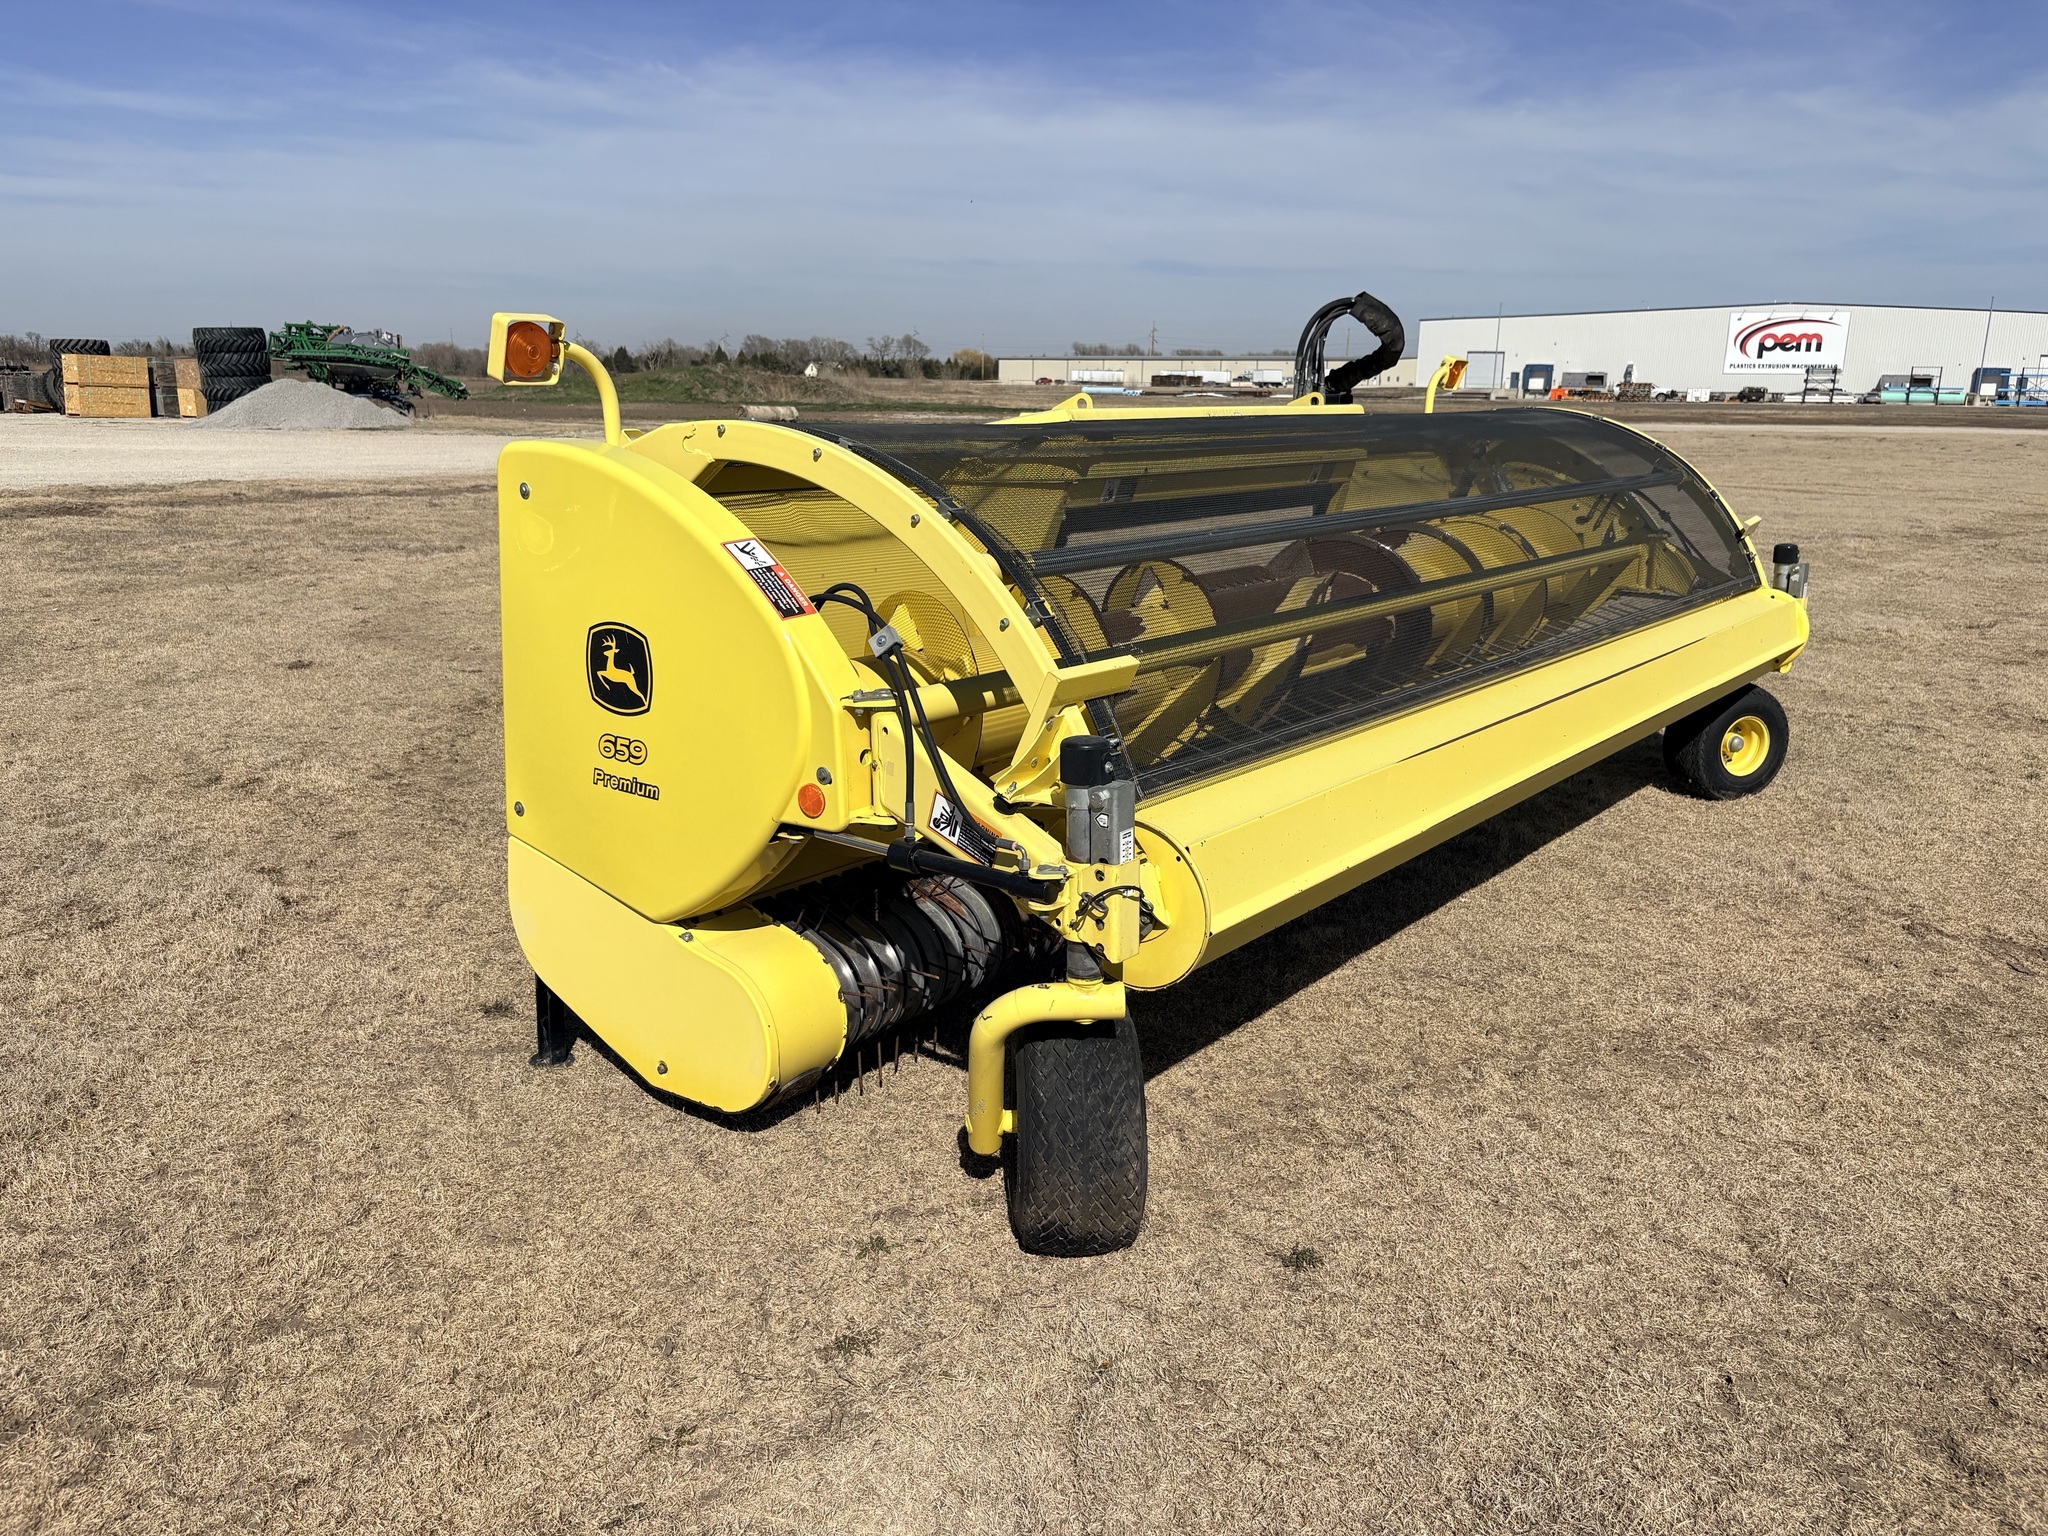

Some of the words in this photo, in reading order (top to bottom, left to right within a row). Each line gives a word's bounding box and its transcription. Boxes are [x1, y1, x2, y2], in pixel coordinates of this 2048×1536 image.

[1757, 333, 1823, 359] pem
[784, 578, 809, 607] DANGER
[598, 733, 648, 766] 659
[593, 767, 660, 801] Premium
